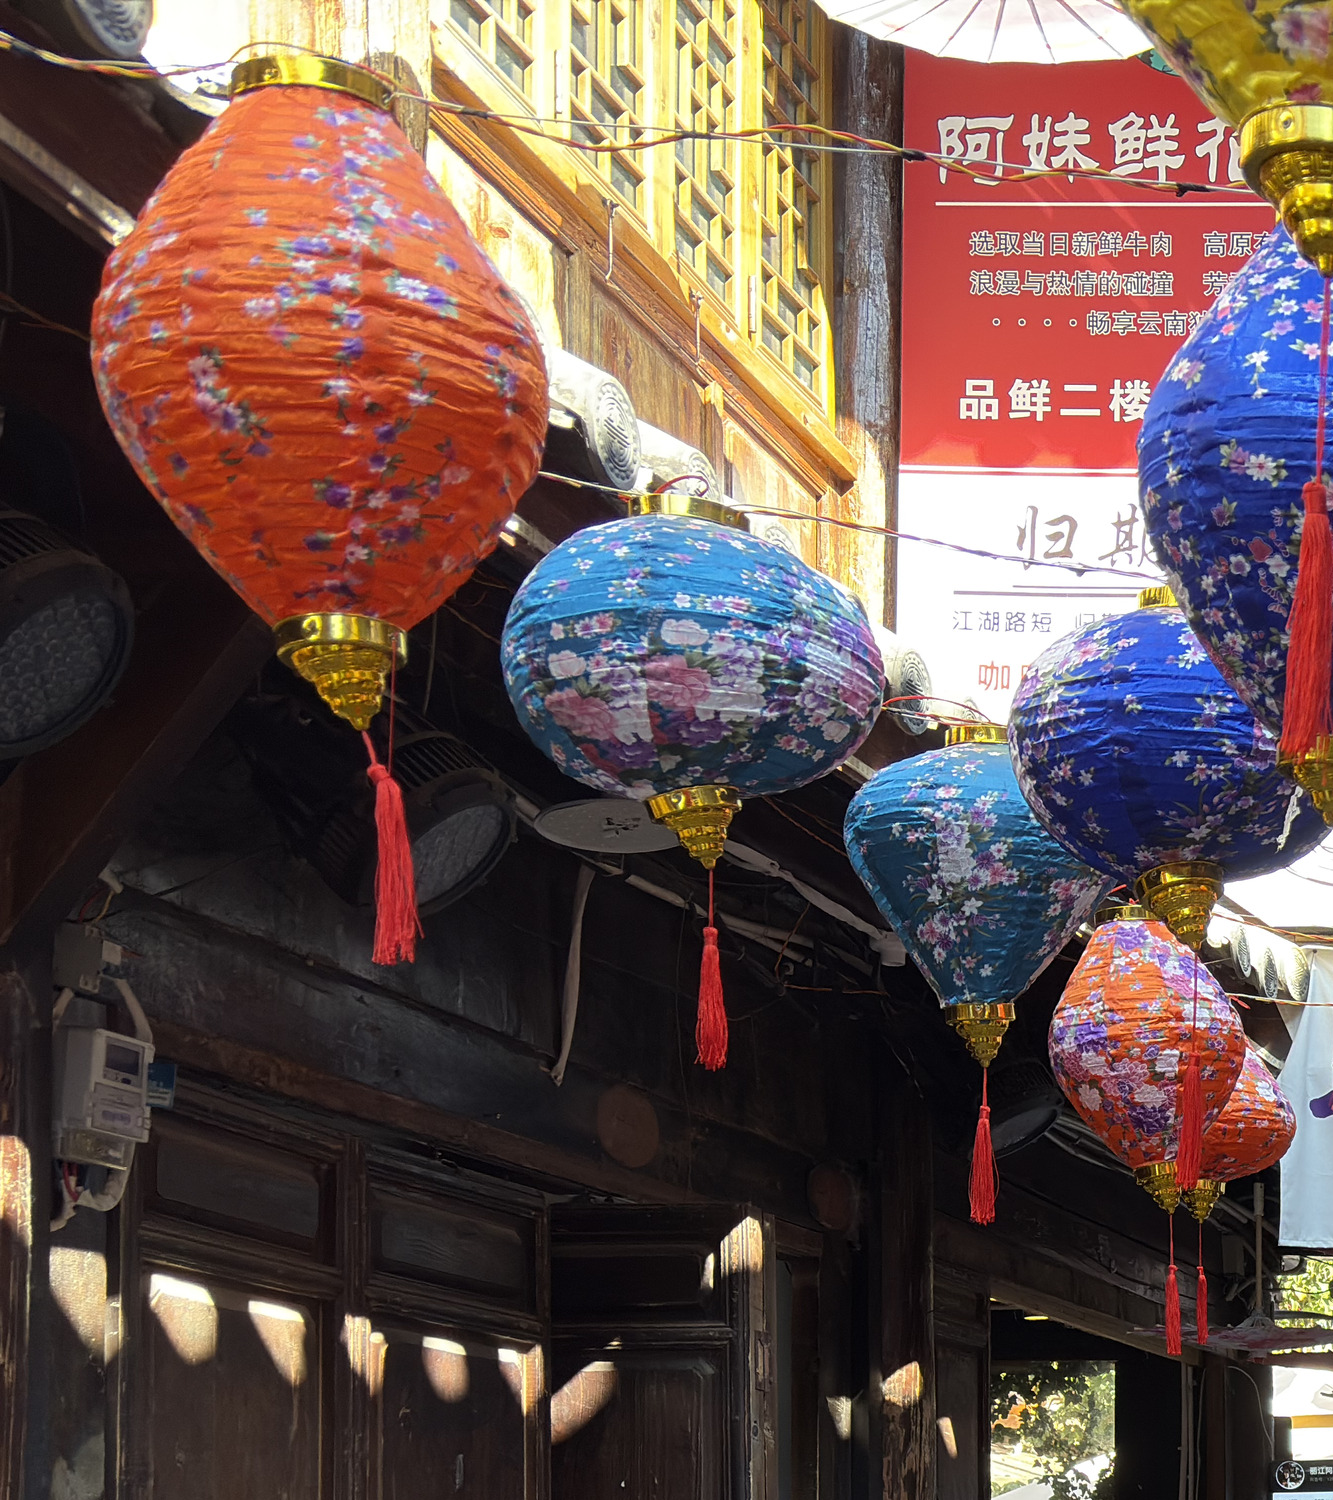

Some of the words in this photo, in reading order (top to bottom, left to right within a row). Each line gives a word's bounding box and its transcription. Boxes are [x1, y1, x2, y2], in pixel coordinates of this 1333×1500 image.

[968, 231, 1173, 257] 选取当日新鲜牛肉
[968, 270, 1174, 297] 浪漫与热情的碰撞
[958, 378, 1151, 423] 品鲜二楼
[952, 610, 1052, 634] 江湖路短
[978, 660, 1033, 692] 咖
